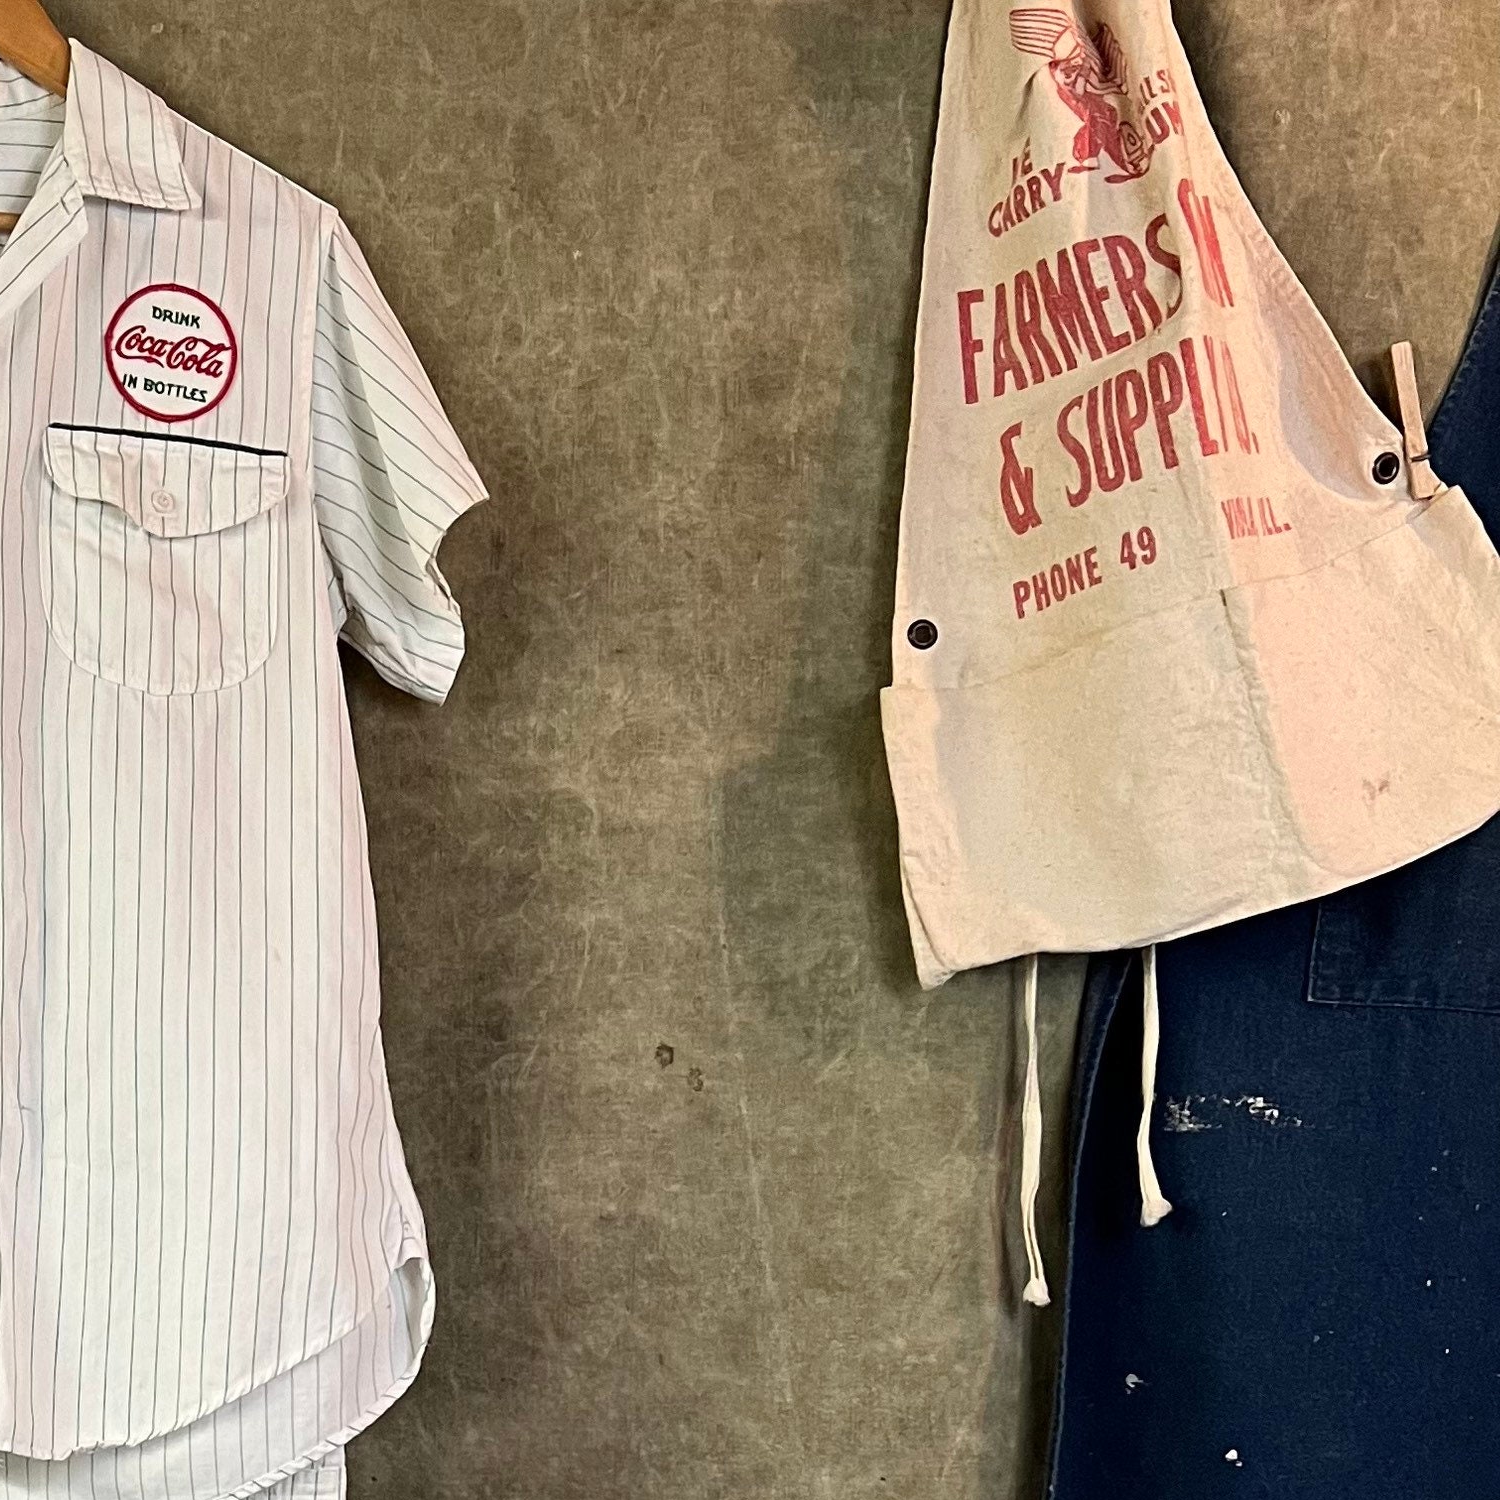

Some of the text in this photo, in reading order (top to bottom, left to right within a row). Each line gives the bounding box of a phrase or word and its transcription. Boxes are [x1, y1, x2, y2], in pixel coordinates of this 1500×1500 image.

[988, 161, 1066, 237] CARRY
[152, 305, 201, 329] DRINK
[957, 213, 1183, 405] FARMERS
[123, 373, 208, 403] IN BOTTLES
[1000, 421, 1043, 536] &
[1013, 526, 1157, 620] PHONE 49
